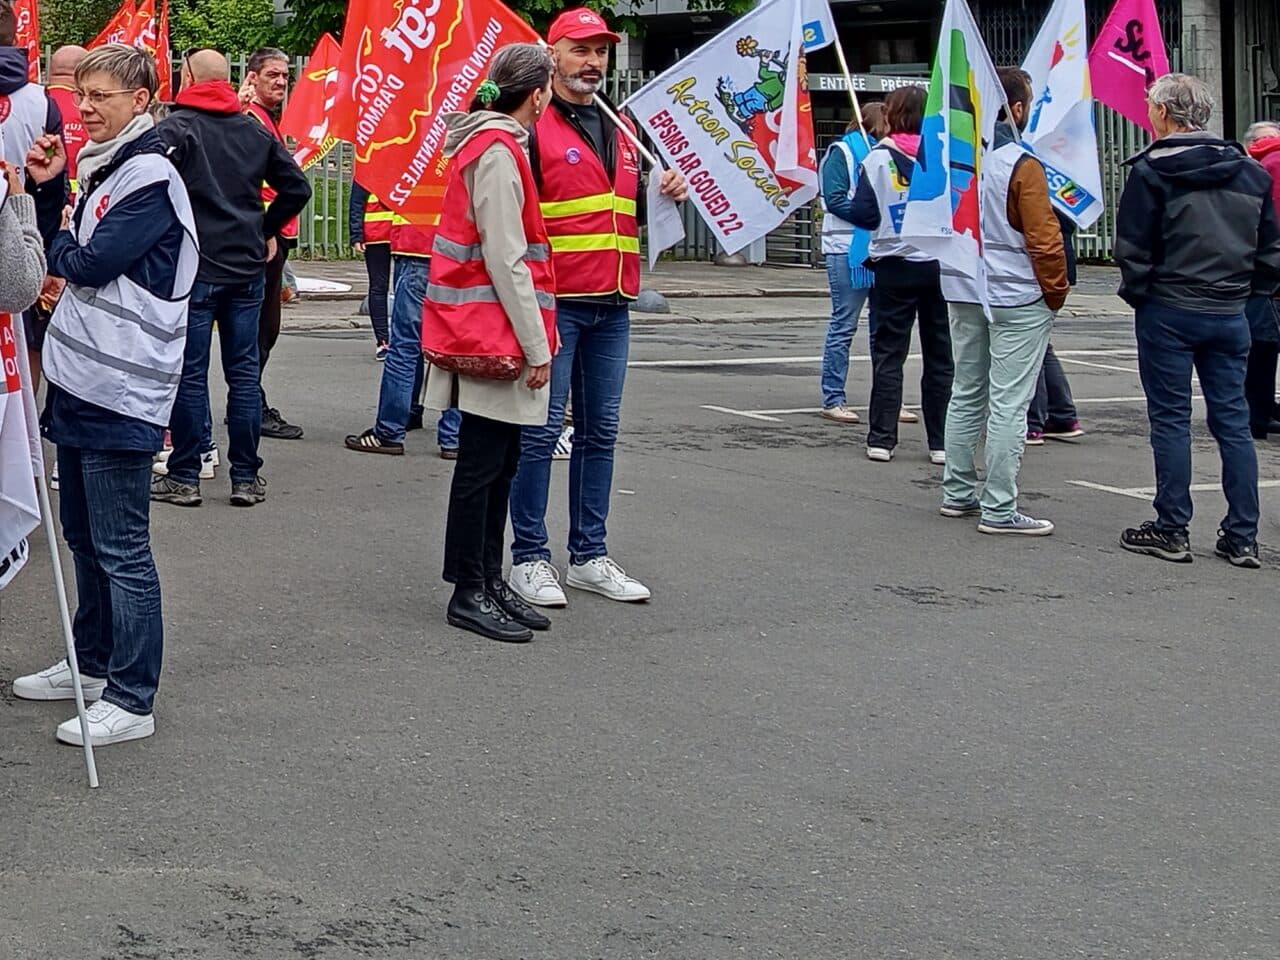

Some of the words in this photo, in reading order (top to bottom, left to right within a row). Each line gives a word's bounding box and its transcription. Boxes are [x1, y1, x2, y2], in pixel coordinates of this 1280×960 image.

[820, 75, 867, 91] ENTÉE
[648, 109, 690, 157] EPSMS
[666, 76, 731, 146] Action
[723, 140, 793, 215] Sociale
[675, 151, 702, 176] AR
[688, 170, 731, 217] GOUED
[716, 212, 744, 237] 22
